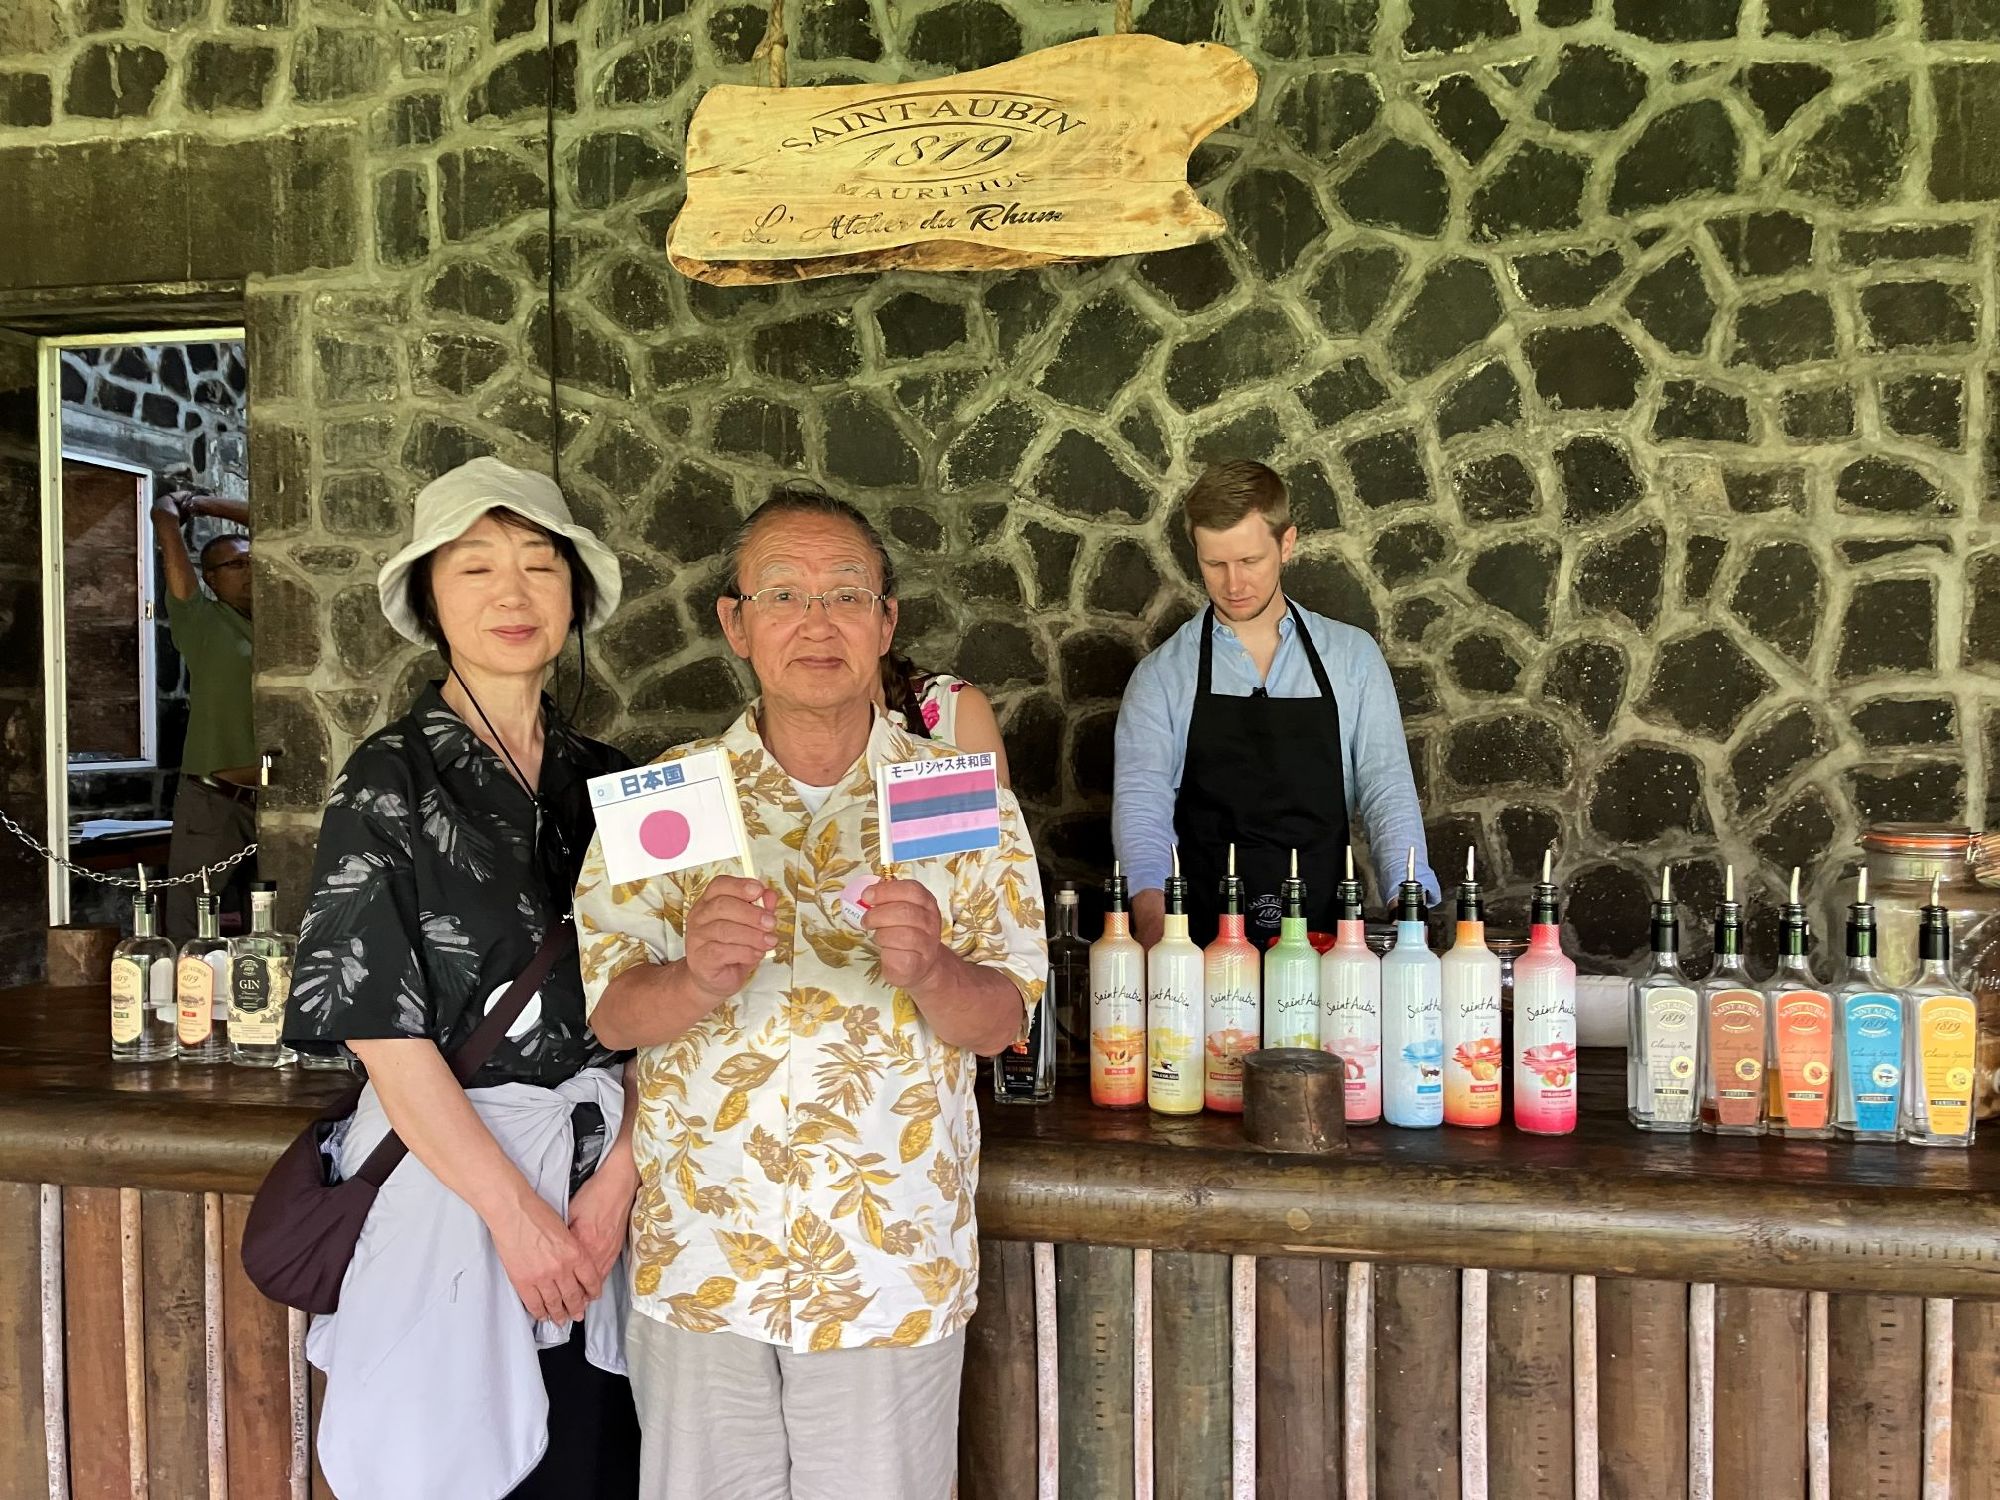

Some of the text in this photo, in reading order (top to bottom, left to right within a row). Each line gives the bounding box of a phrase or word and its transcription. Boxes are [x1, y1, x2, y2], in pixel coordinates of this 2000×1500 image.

[781, 98, 1086, 151] SAINT AUBIN
[855, 134, 1012, 171] 1819
[832, 171, 1035, 200] MAURITIUS
[799, 211, 914, 240] Atelier
[920, 210, 961, 231] du
[966, 202, 1065, 231] Rhum
[891, 753, 992, 779] モーリシャス共和国
[620, 763, 686, 797] 日本国
[239, 980, 260, 990] GIN
[1210, 989, 1231, 1008] Saint
[1277, 994, 1306, 1013] Saint
[1326, 997, 1350, 1016] Saint
[1526, 1000, 1556, 1021] Saint
[1659, 1013, 1687, 1022] 1819
[1935, 1021, 1961, 1033] 1819
